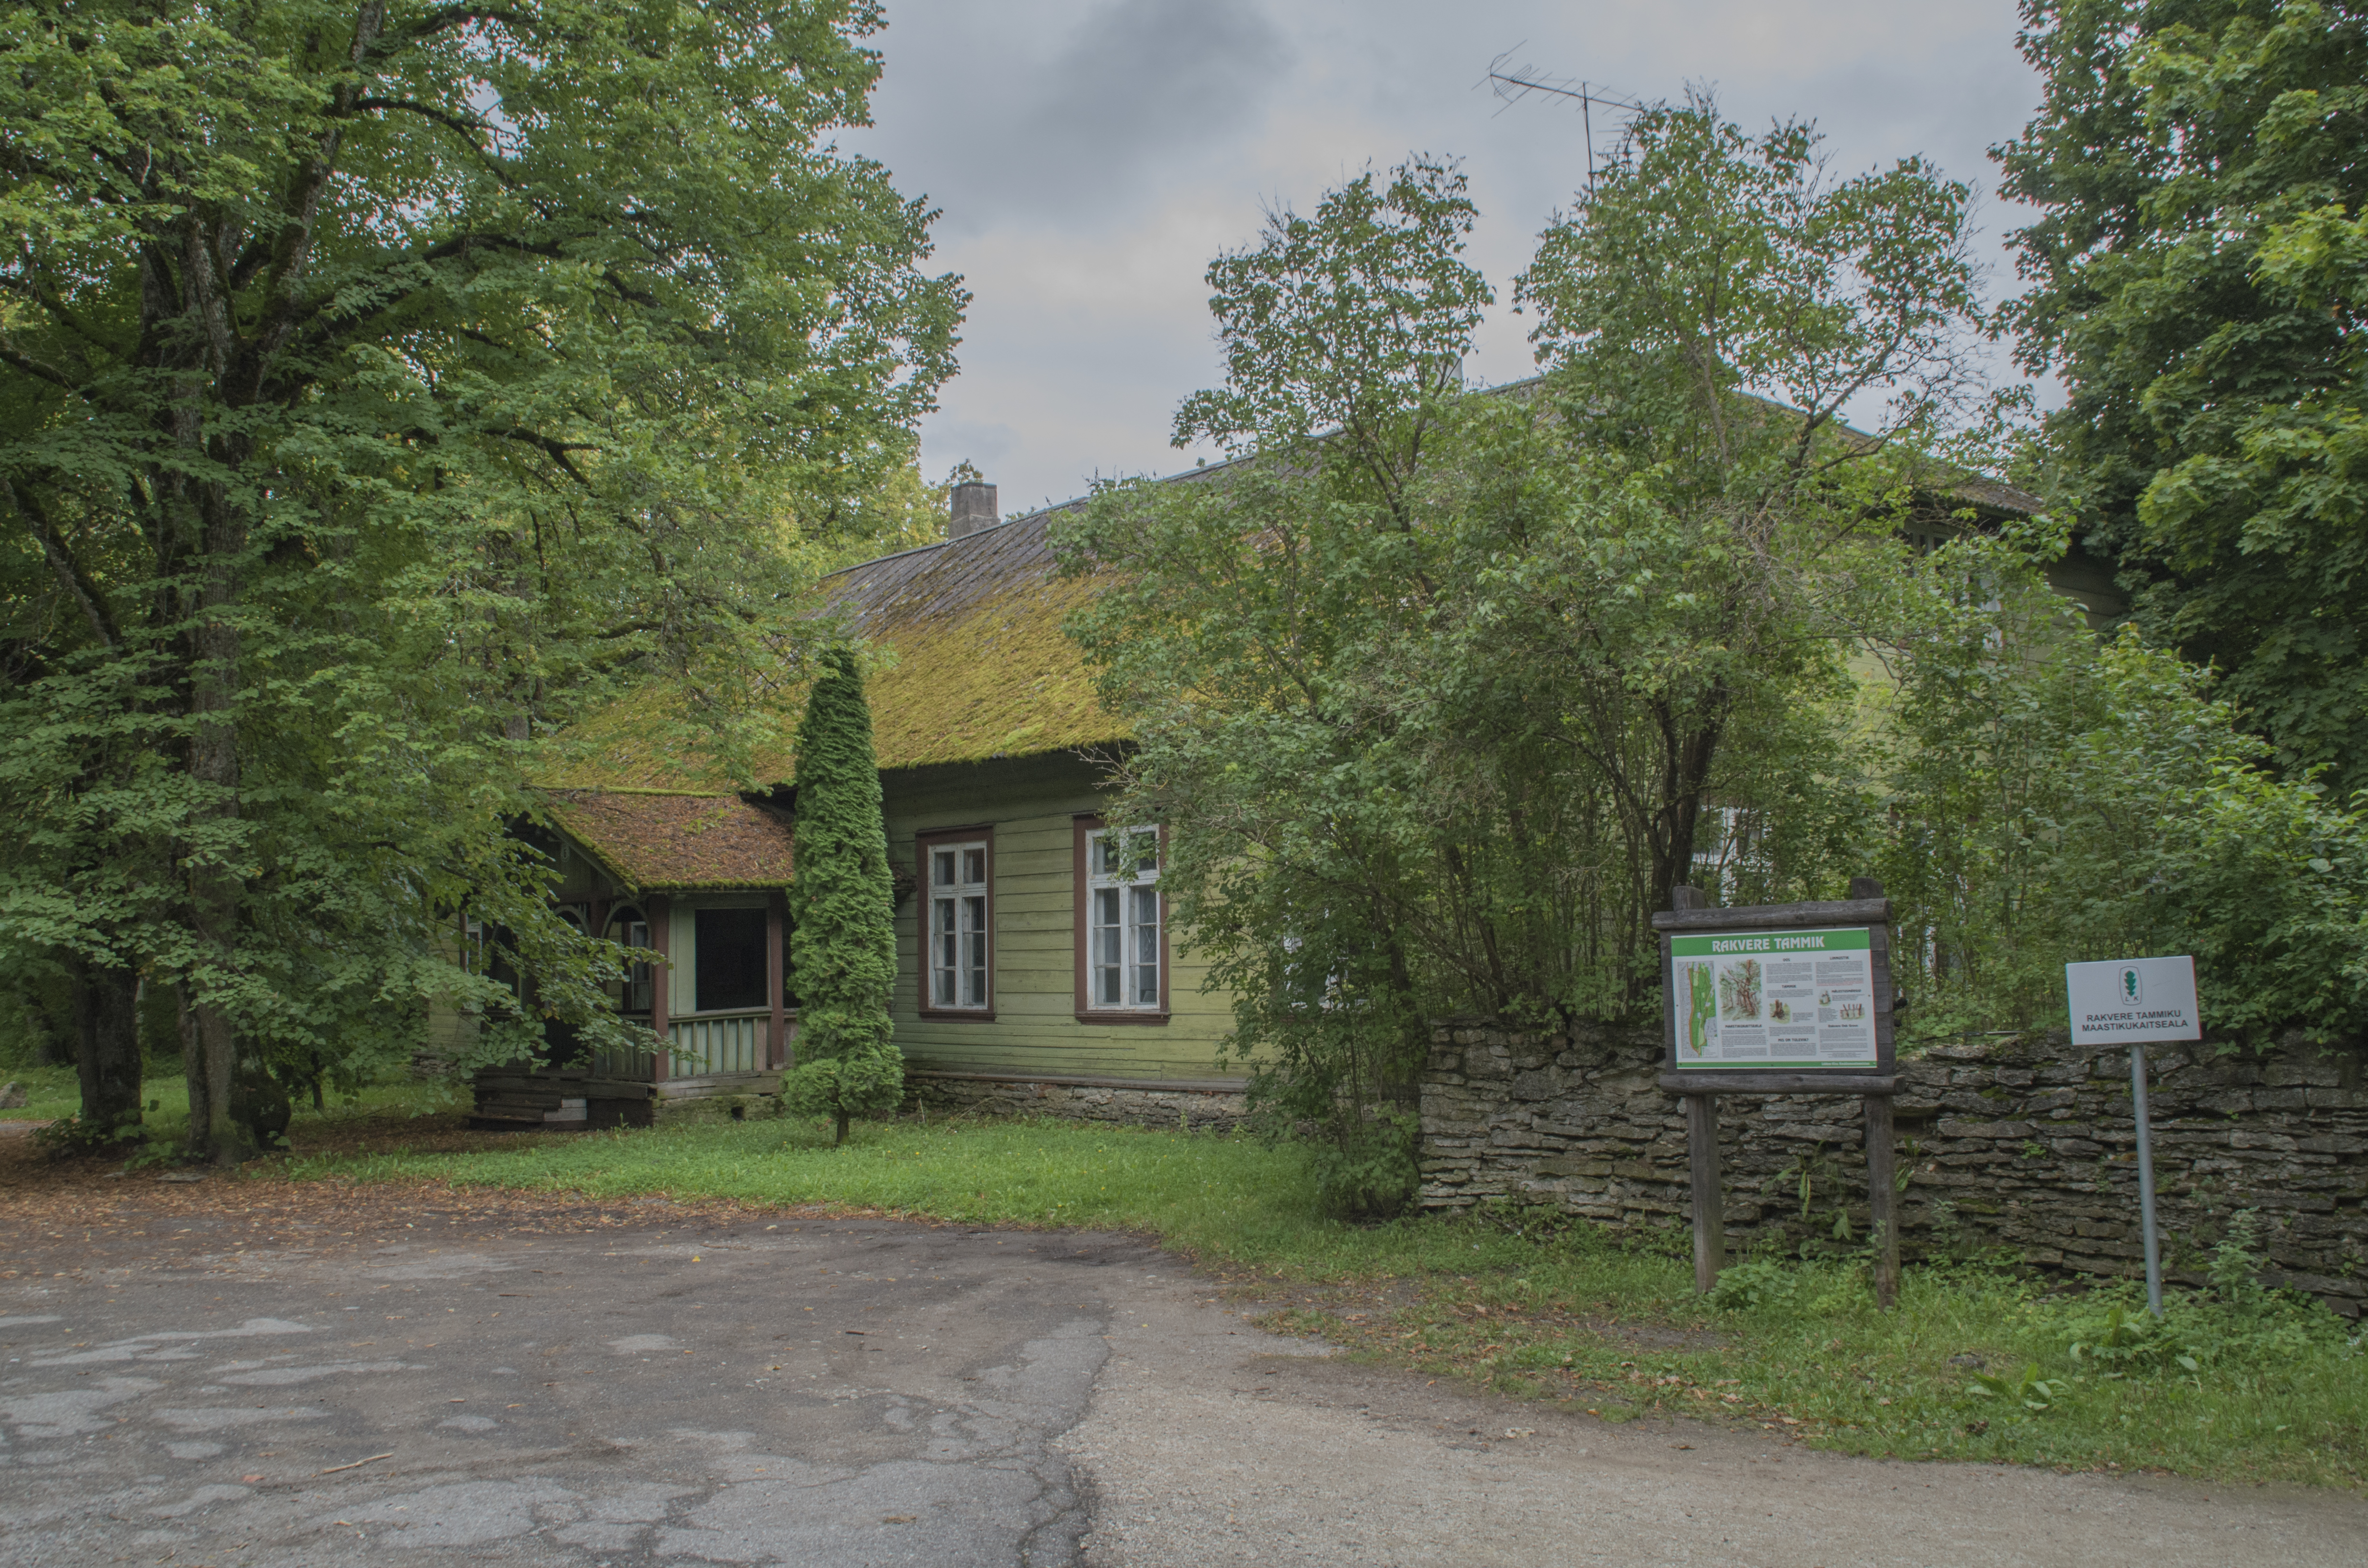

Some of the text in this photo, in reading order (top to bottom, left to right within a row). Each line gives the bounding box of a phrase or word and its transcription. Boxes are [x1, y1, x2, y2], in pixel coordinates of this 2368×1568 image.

[1712, 936, 1825, 953] RAKVERE TAMMIK
[2086, 1009, 2182, 1022] RAKVERE TAMMIKU
[2082, 1019, 2188, 1032] MAASTIKUKAITSEALA
